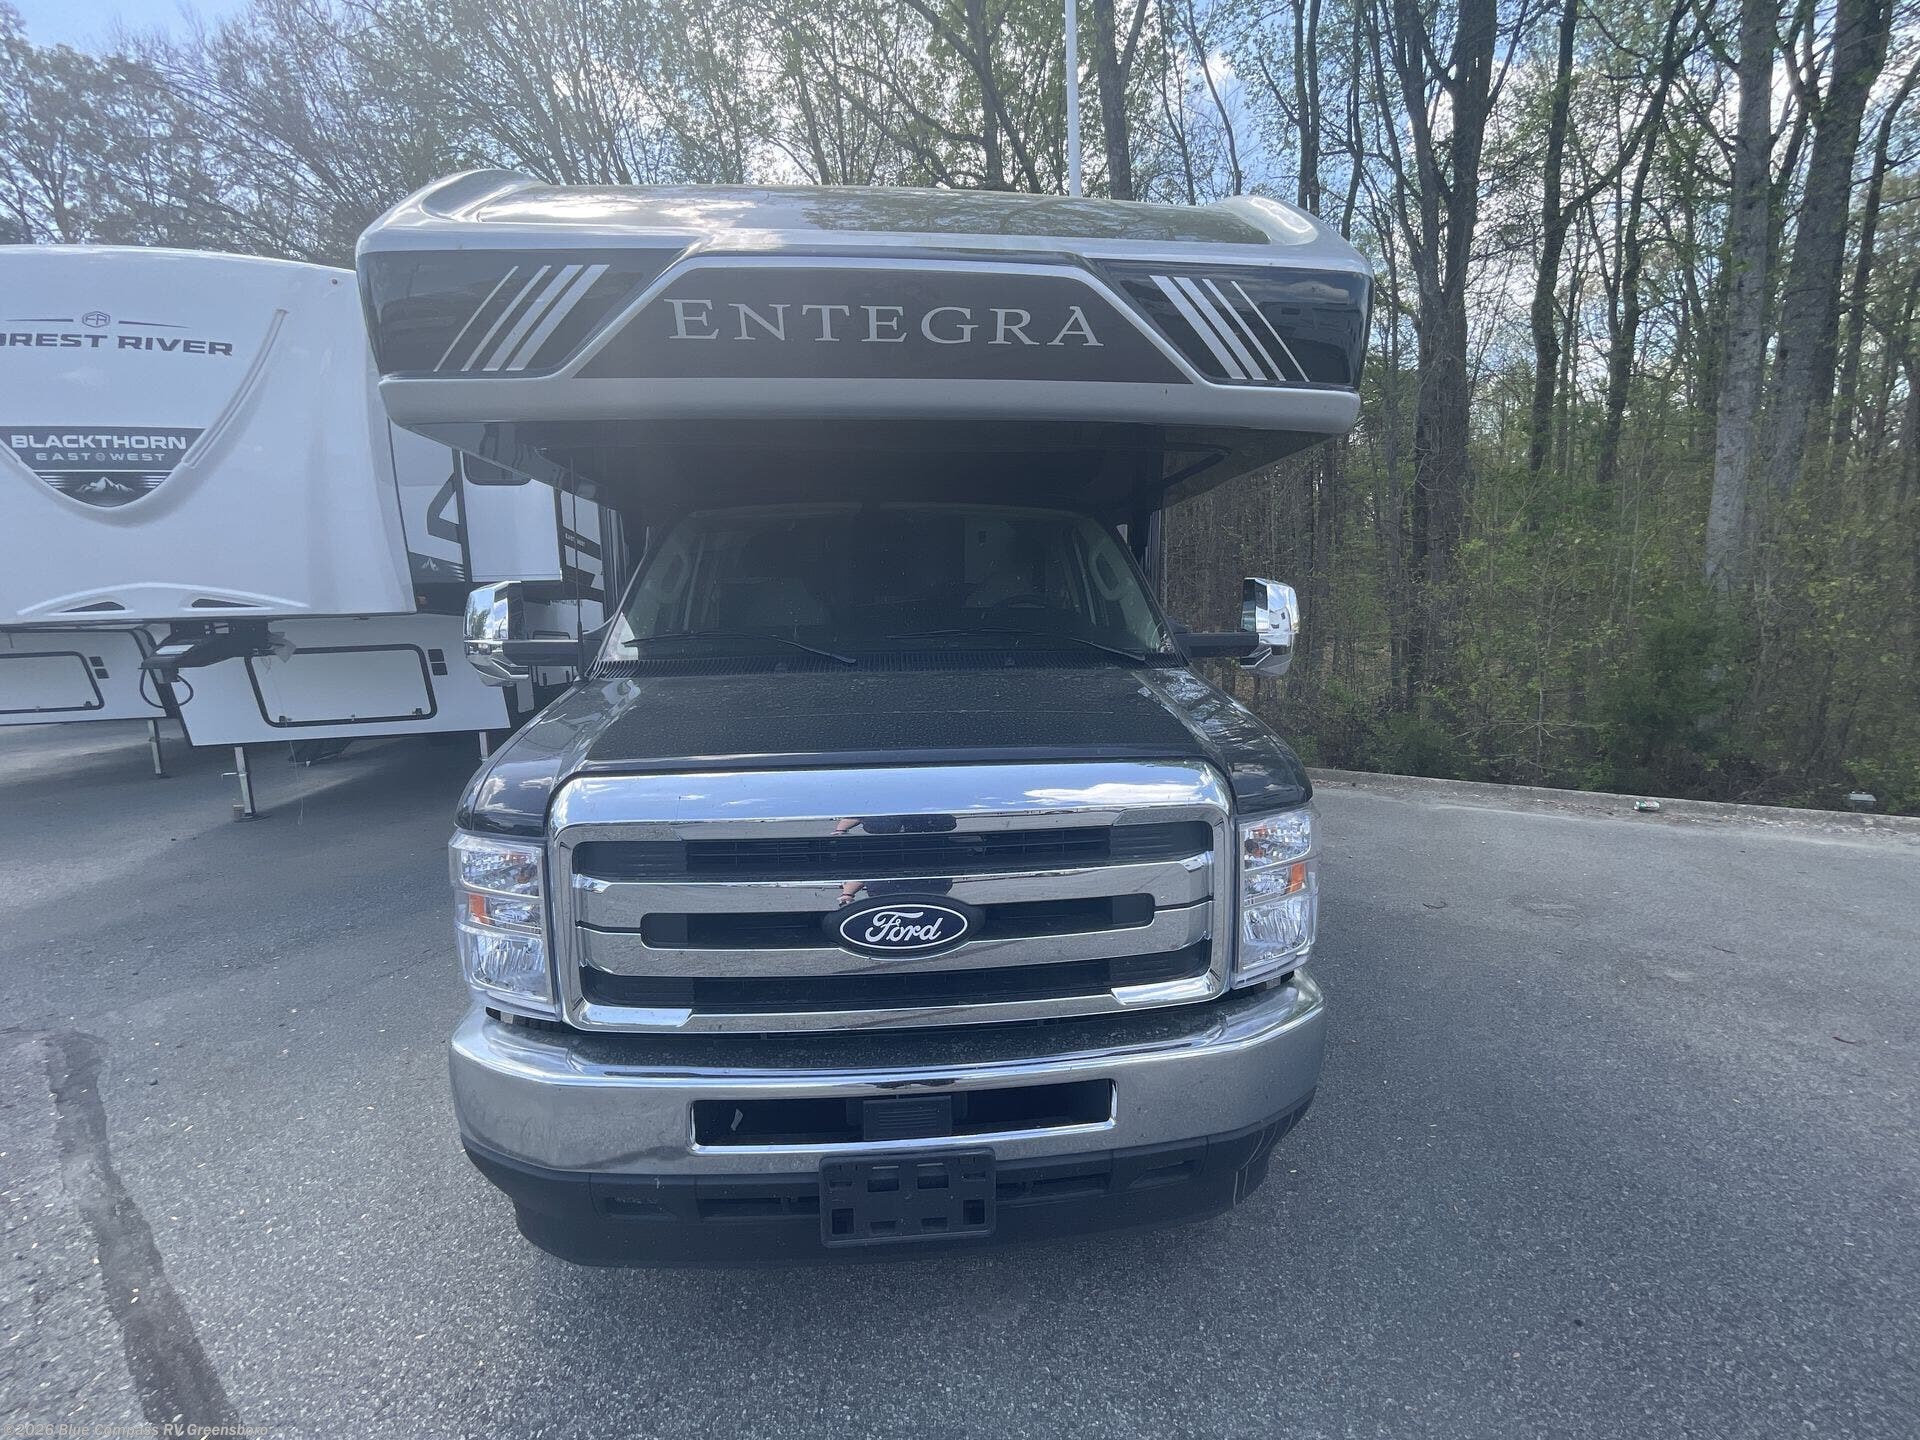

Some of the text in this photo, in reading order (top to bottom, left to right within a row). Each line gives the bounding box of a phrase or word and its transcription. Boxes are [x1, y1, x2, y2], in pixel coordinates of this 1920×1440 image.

[663, 298, 1105, 347] ENTEGRA
[0, 333, 233, 357] REST RIVER
[10, 434, 187, 450] BLACKTHORN
[35, 452, 165, 462] EAST WEST
[864, 911, 944, 942] Ford
